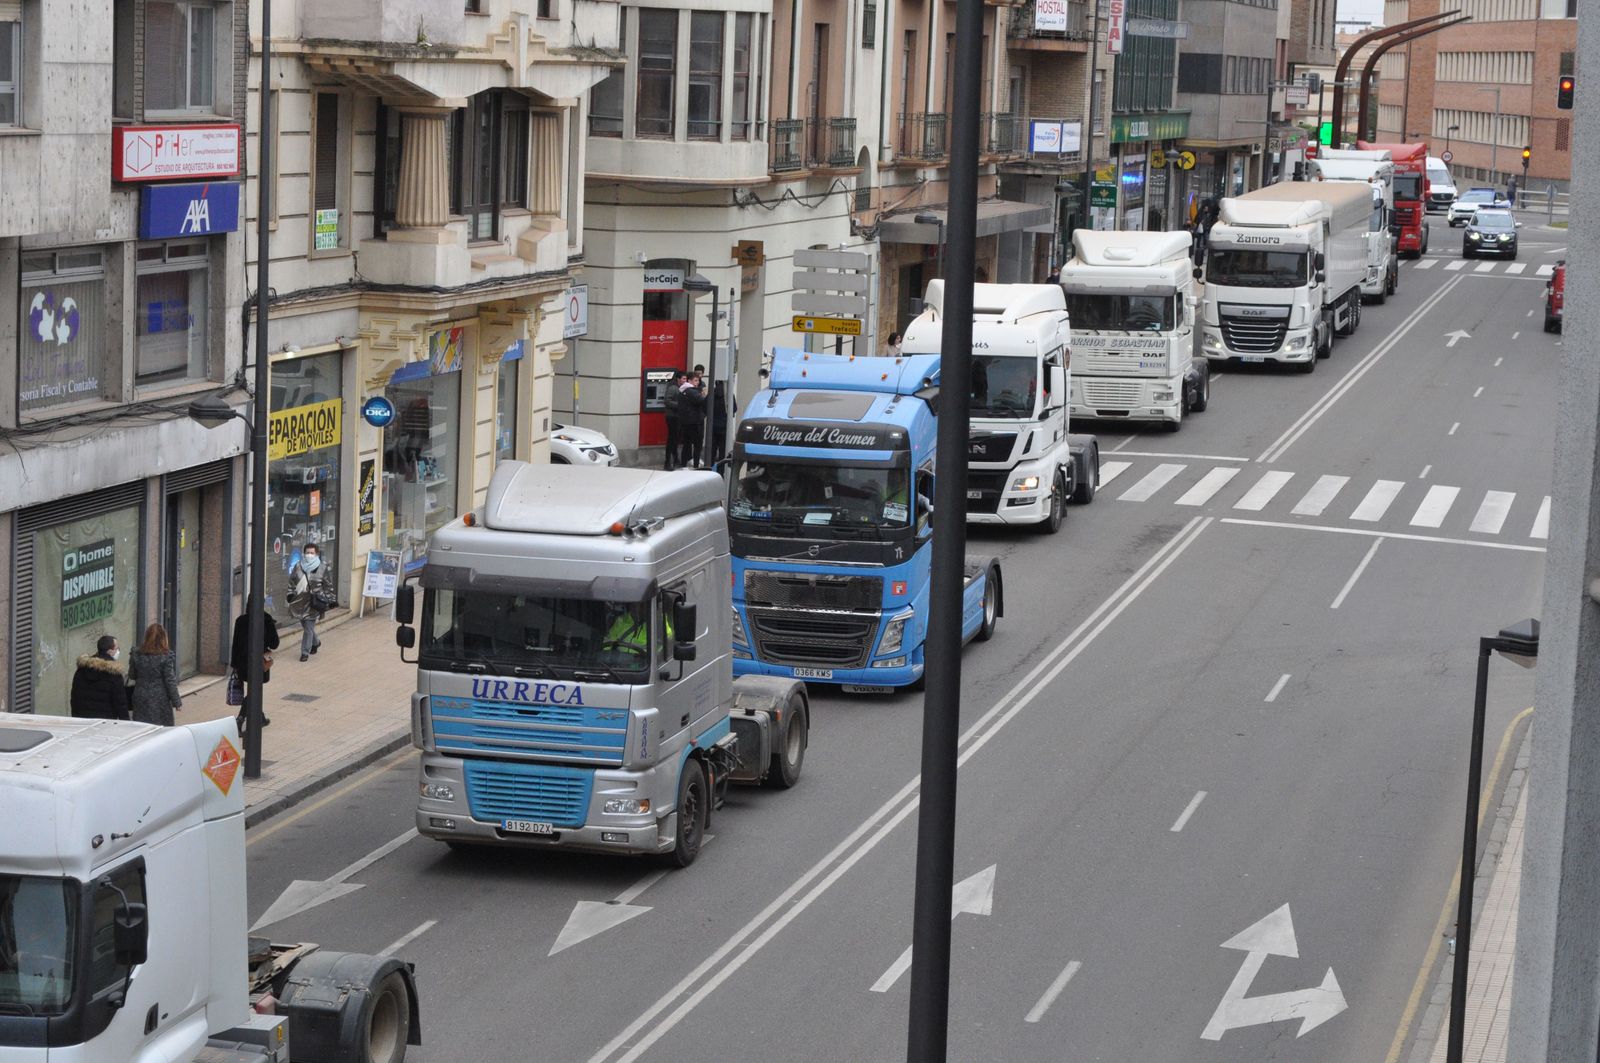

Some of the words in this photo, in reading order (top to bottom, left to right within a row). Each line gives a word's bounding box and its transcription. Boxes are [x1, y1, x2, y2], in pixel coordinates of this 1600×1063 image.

[1038, 1, 1065, 14] HOSTAL
[1107, 0, 1122, 53] STAL
[155, 164, 174, 173] ESTUDIO
[175, 163, 182, 172] DE
[182, 162, 214, 173] ARQUITECTURA
[180, 198, 211, 234] AXA
[1237, 233, 1280, 244] Zamora
[41, 382, 60, 397] Fiscal
[62, 384, 67, 398] y
[69, 376, 98, 393] Contable
[365, 409, 390, 417] DIGI
[763, 425, 802, 446] Virgen
[804, 427, 826, 444] del
[827, 428, 876, 446] Carmen
[287, 438, 297, 453] DE
[63, 566, 114, 601] DISPONIBLE
[63, 605, 79, 628] 980
[80, 599, 96, 622] 530
[97, 594, 113, 617] 475
[795, 668, 814, 677] 0366
[816, 669, 831, 677] KMS
[472, 678, 584, 705] URRECA
[434, 700, 471, 709] DAF
[507, 821, 530, 832] 8192
[533, 823, 551, 833] DZX
